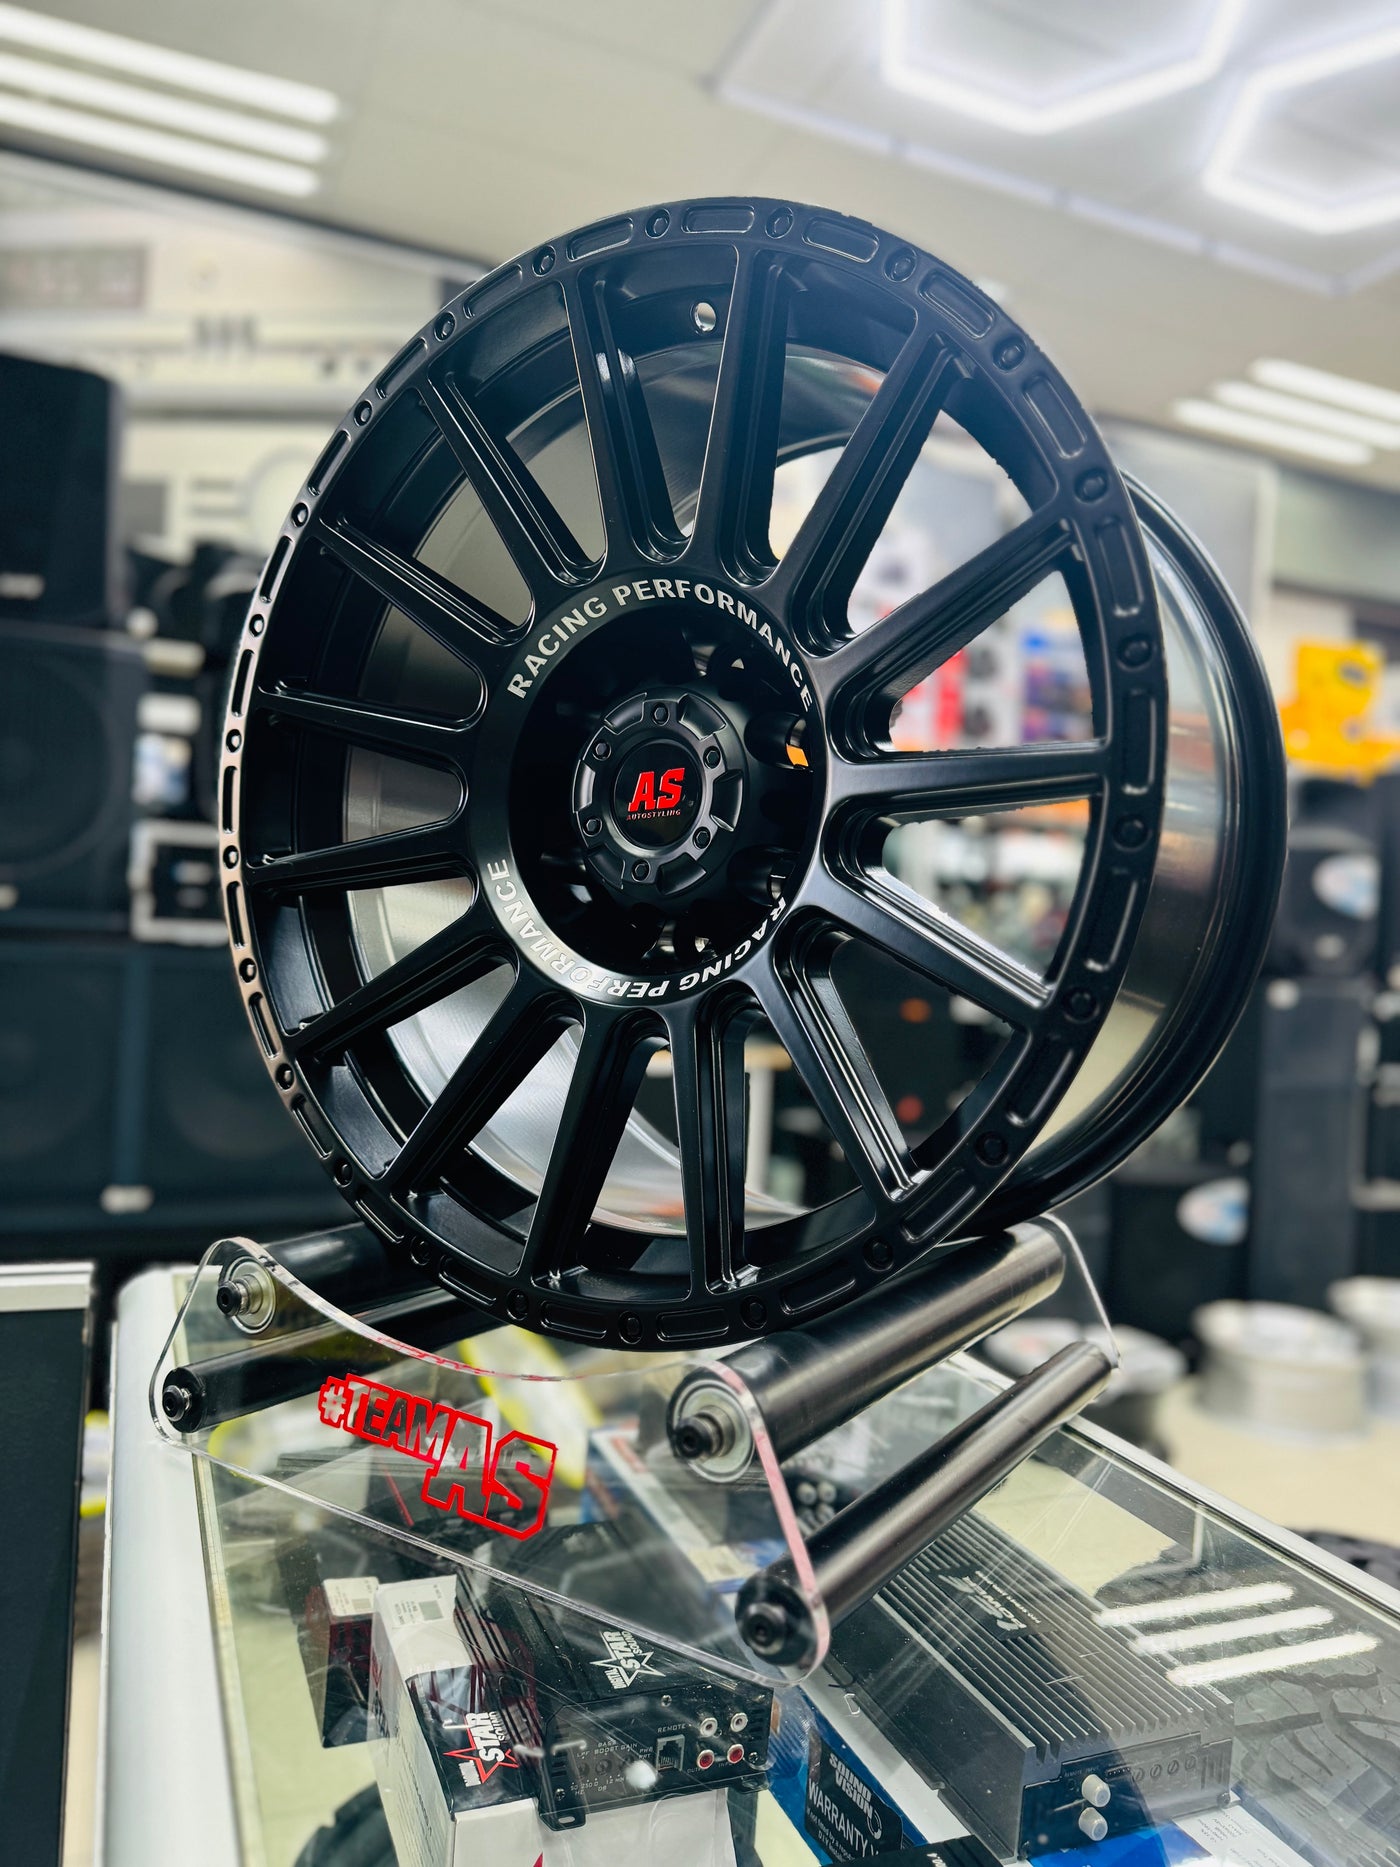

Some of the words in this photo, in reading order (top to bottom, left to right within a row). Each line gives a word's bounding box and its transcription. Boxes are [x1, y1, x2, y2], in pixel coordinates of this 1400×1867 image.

[507, 595, 608, 699] RACING
[611, 578, 813, 712] PERFORMANCE
[628, 767, 685, 812] AS
[627, 809, 681, 821] AUTOSTYLING
[487, 858, 669, 998] PERFORMANCE
[679, 896, 787, 998] RACING
[603, 1631, 641, 1670] STAR
[621, 1630, 643, 1655] SOUND
[466, 1712, 505, 1762] STAR
[657, 1723, 686, 1733] REMOTE
[829, 1752, 872, 1802] SOUND
[835, 1770, 874, 1820] VISION
[808, 1778, 868, 1858] WARRANTY
